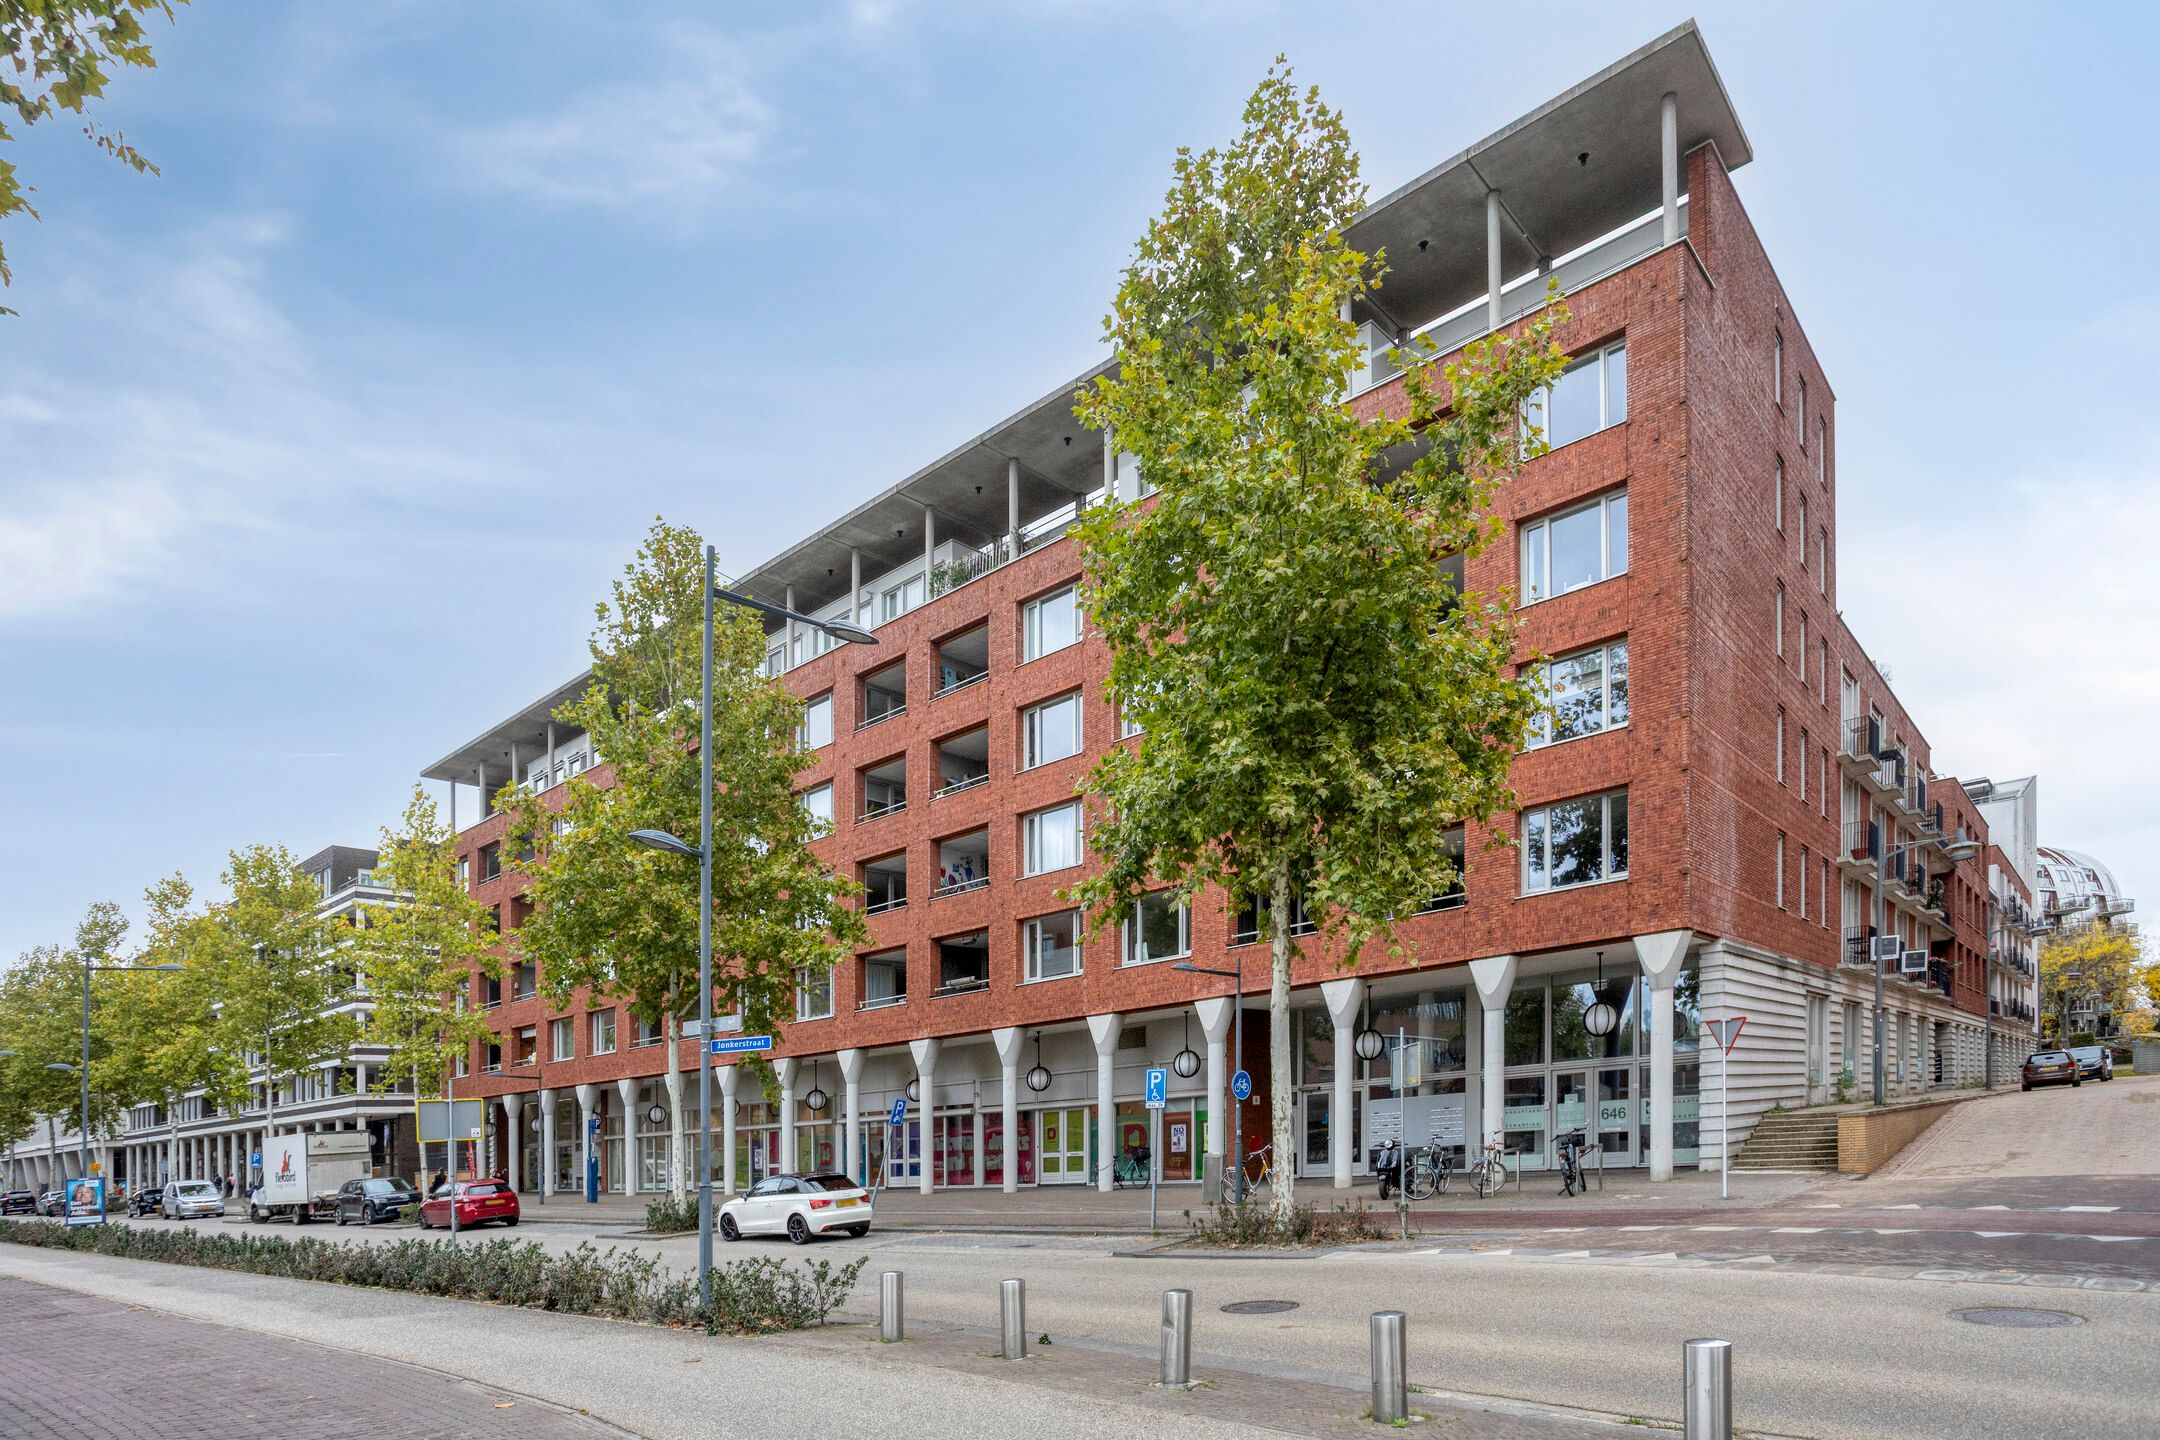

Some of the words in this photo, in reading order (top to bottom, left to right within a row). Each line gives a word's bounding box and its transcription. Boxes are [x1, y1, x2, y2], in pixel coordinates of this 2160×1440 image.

[717, 1039, 765, 1049] Jonkerstraat
[1151, 1072, 1162, 1089] P
[896, 1101, 904, 1115] P
[1601, 1106, 1626, 1120] 646
[595, 1119, 600, 1128] P
[253, 1155, 260, 1164] P
